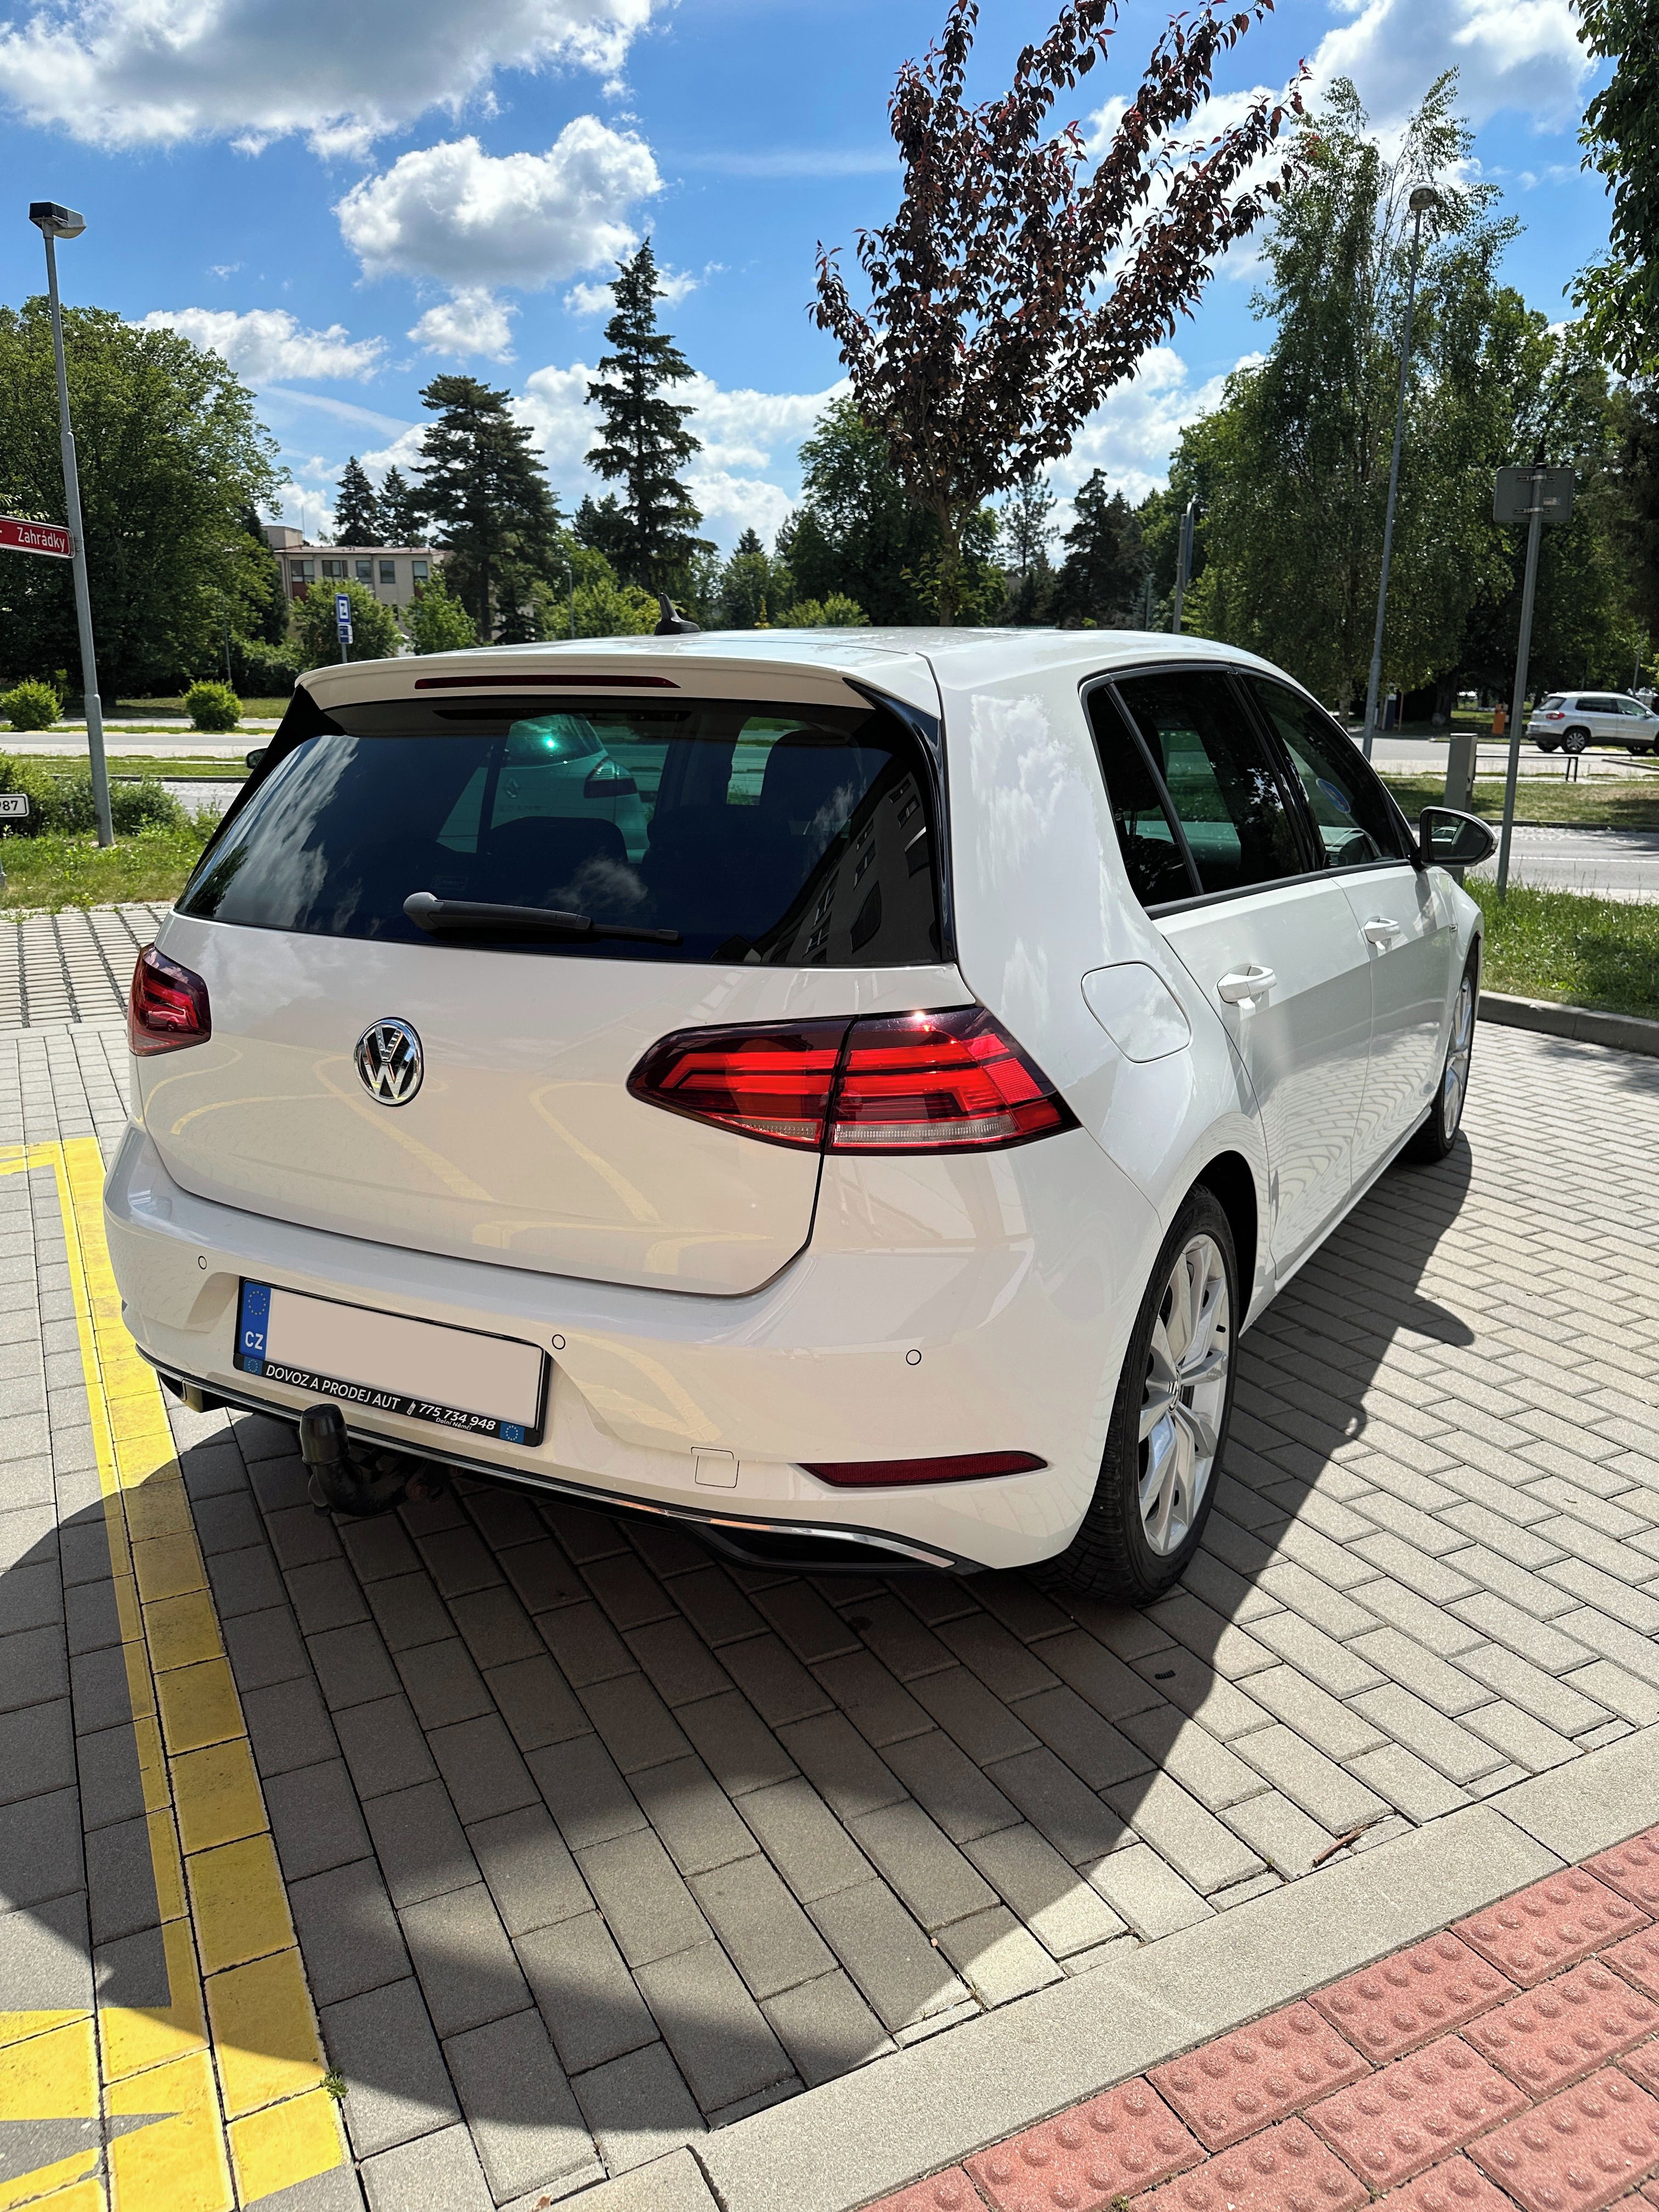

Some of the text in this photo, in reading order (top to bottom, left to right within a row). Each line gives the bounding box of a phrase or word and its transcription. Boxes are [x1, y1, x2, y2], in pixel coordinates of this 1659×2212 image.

[17, 527, 65, 552] Zahrádky
[0, 800, 18, 811] 87
[245, 1331, 263, 1350] CZ
[266, 1364, 496, 1430] DOVOZ A PRODEJ AUT 775 734 948
[436, 1417, 452, 1426] Dolní
